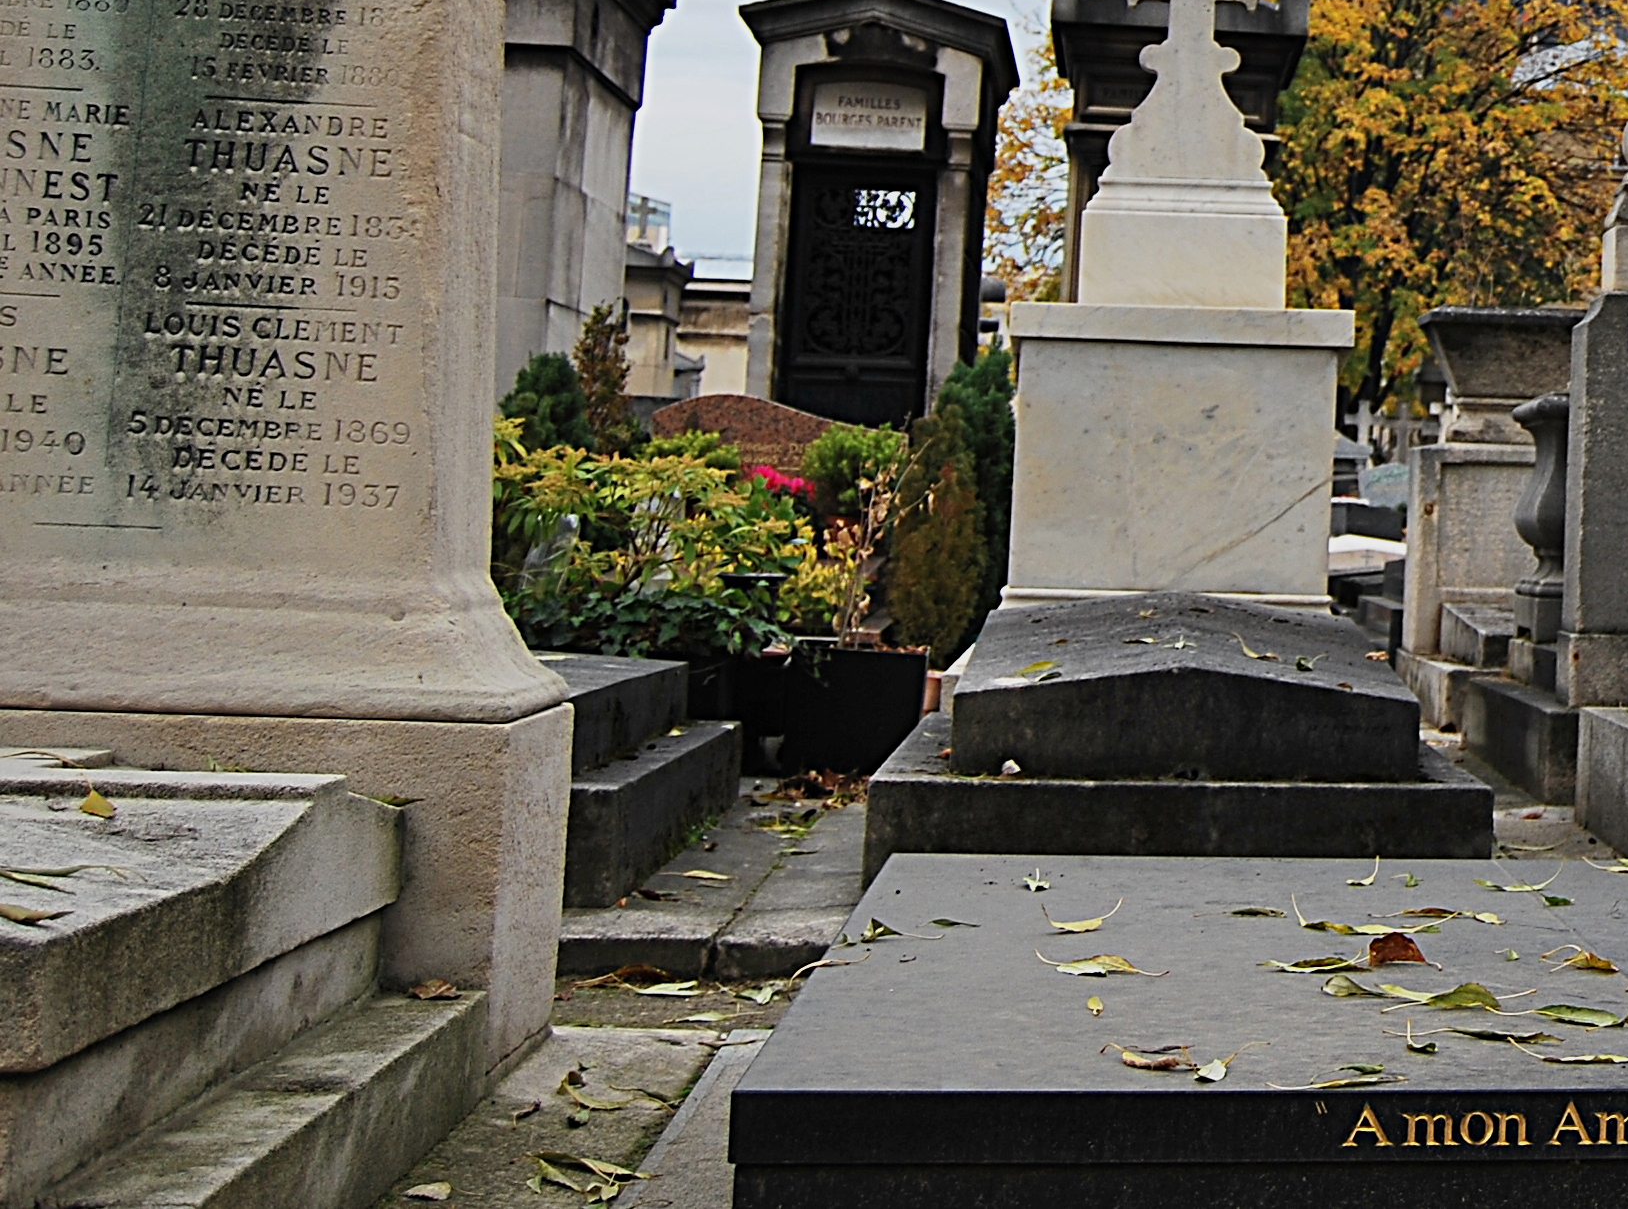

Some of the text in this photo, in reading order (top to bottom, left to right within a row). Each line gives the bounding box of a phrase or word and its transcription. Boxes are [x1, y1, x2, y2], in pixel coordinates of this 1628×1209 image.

[219, 0, 347, 25] DÉCEMBRE
[47, 23, 77, 39] LE
[219, 29, 349, 55] DÉCÉDÉ LE
[227, 56, 330, 84] FÉVRIER
[42, 100, 130, 125] MARIE
[838, 95, 901, 111] FAMILLES
[191, 109, 389, 140] ALEXANDRE
[815, 112, 922, 128] BOURGES PARENT
[185, 139, 393, 178] THUASNE
[240, 176, 330, 205] NÉ LE
[26, 207, 111, 229] PARIS
[177, 202, 342, 236] DÉCEMBRE
[32, 230, 103, 256] 1895
[197, 236, 368, 268] DÉCÉDÉ LE
[153, 265, 400, 300] 8 JANVIER 1915
[144, 311, 242, 338] LOUIS
[172, 344, 379, 383] THUASNE
[6, 393, 48, 414] LE
[222, 382, 317, 411] NÉ LE
[128, 409, 411, 445] 5 DÉCEMBRE 1869
[1, 428, 87, 456] 1940
[172, 441, 361, 476] DÉCÉDÉ LE
[126, 474, 400, 509] 14 JANVIER 1937
[1401, 1108, 1534, 1147] mon
